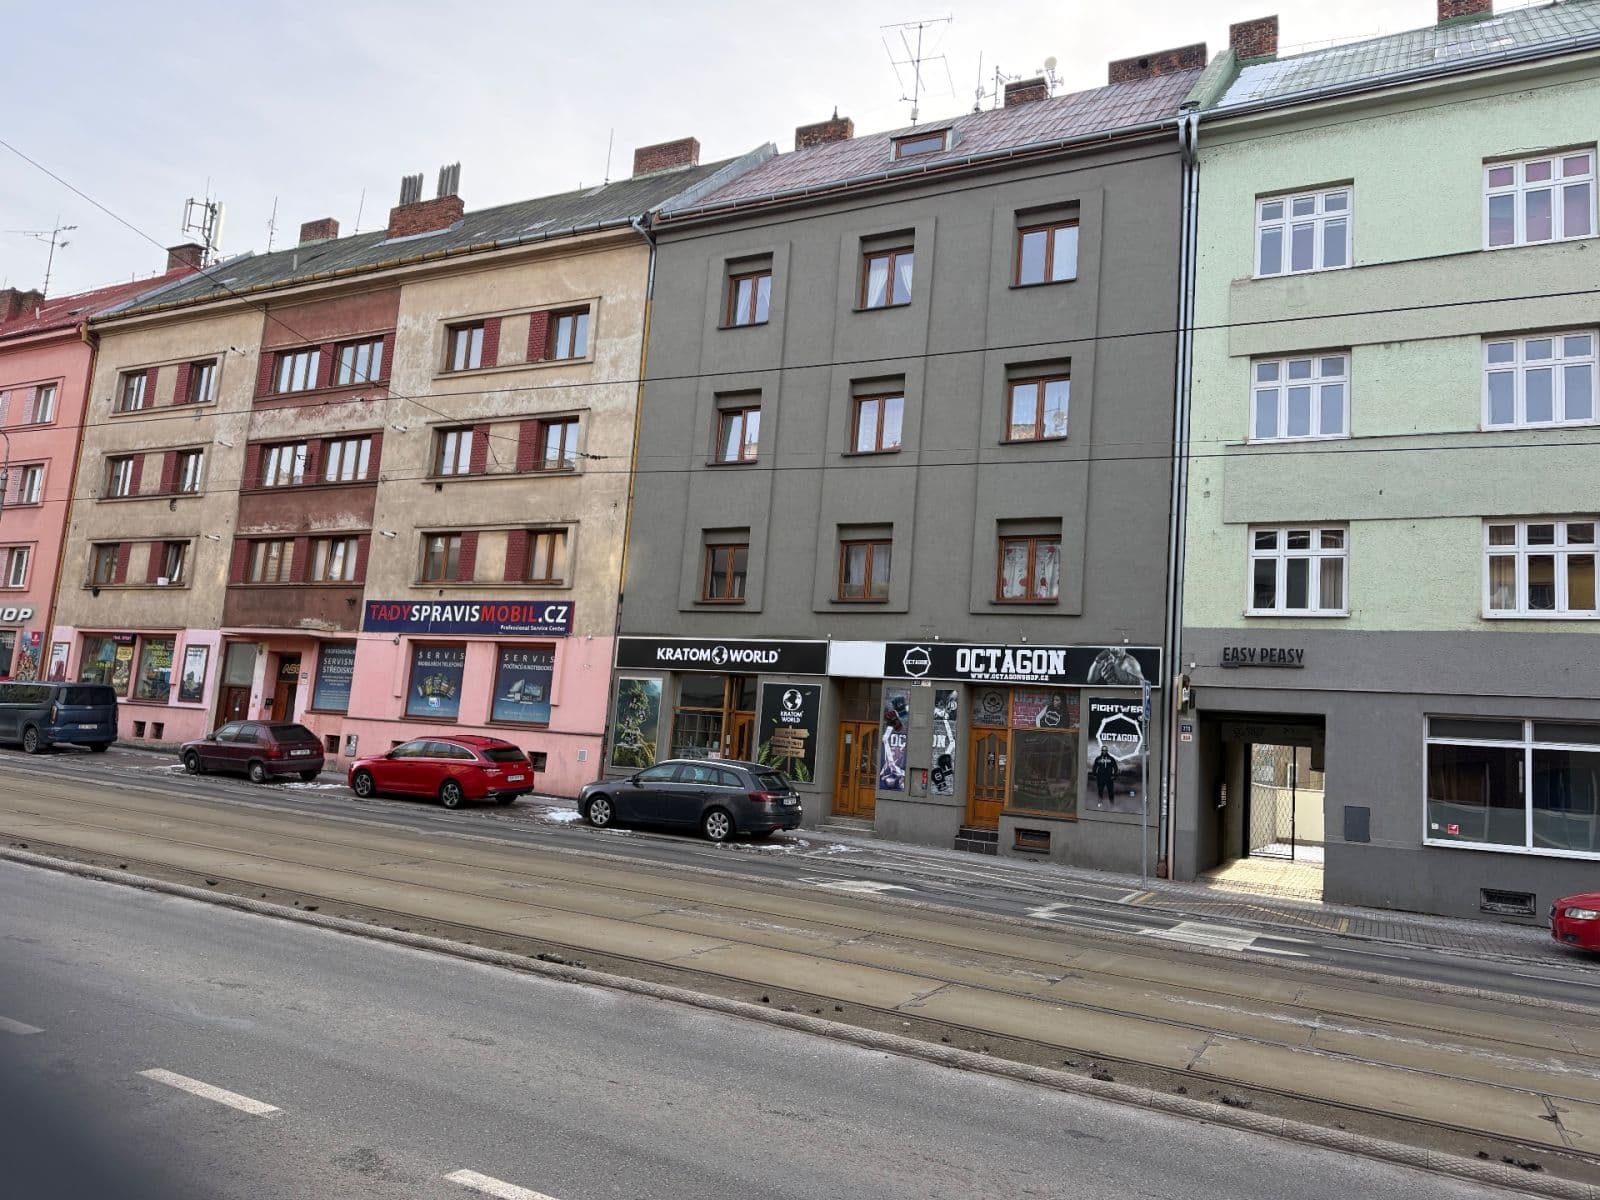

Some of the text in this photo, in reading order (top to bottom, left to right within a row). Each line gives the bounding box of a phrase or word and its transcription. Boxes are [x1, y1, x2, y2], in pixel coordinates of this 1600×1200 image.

[370, 604, 568, 623] TADYSPRAVISMOBIL.CZ
[418, 651, 465, 660] SERVIS
[504, 653, 555, 663] SERVIS
[657, 647, 778, 663] KRATOM WORLD
[1223, 647, 1304, 664] EASY PEASY
[323, 657, 353, 666] SERVISN
[956, 648, 1066, 675] OCTAGON
[970, 673, 1049, 681] WWW.OCTAGONSHOP.CZ
[1101, 733, 1138, 742] OCTAGON
